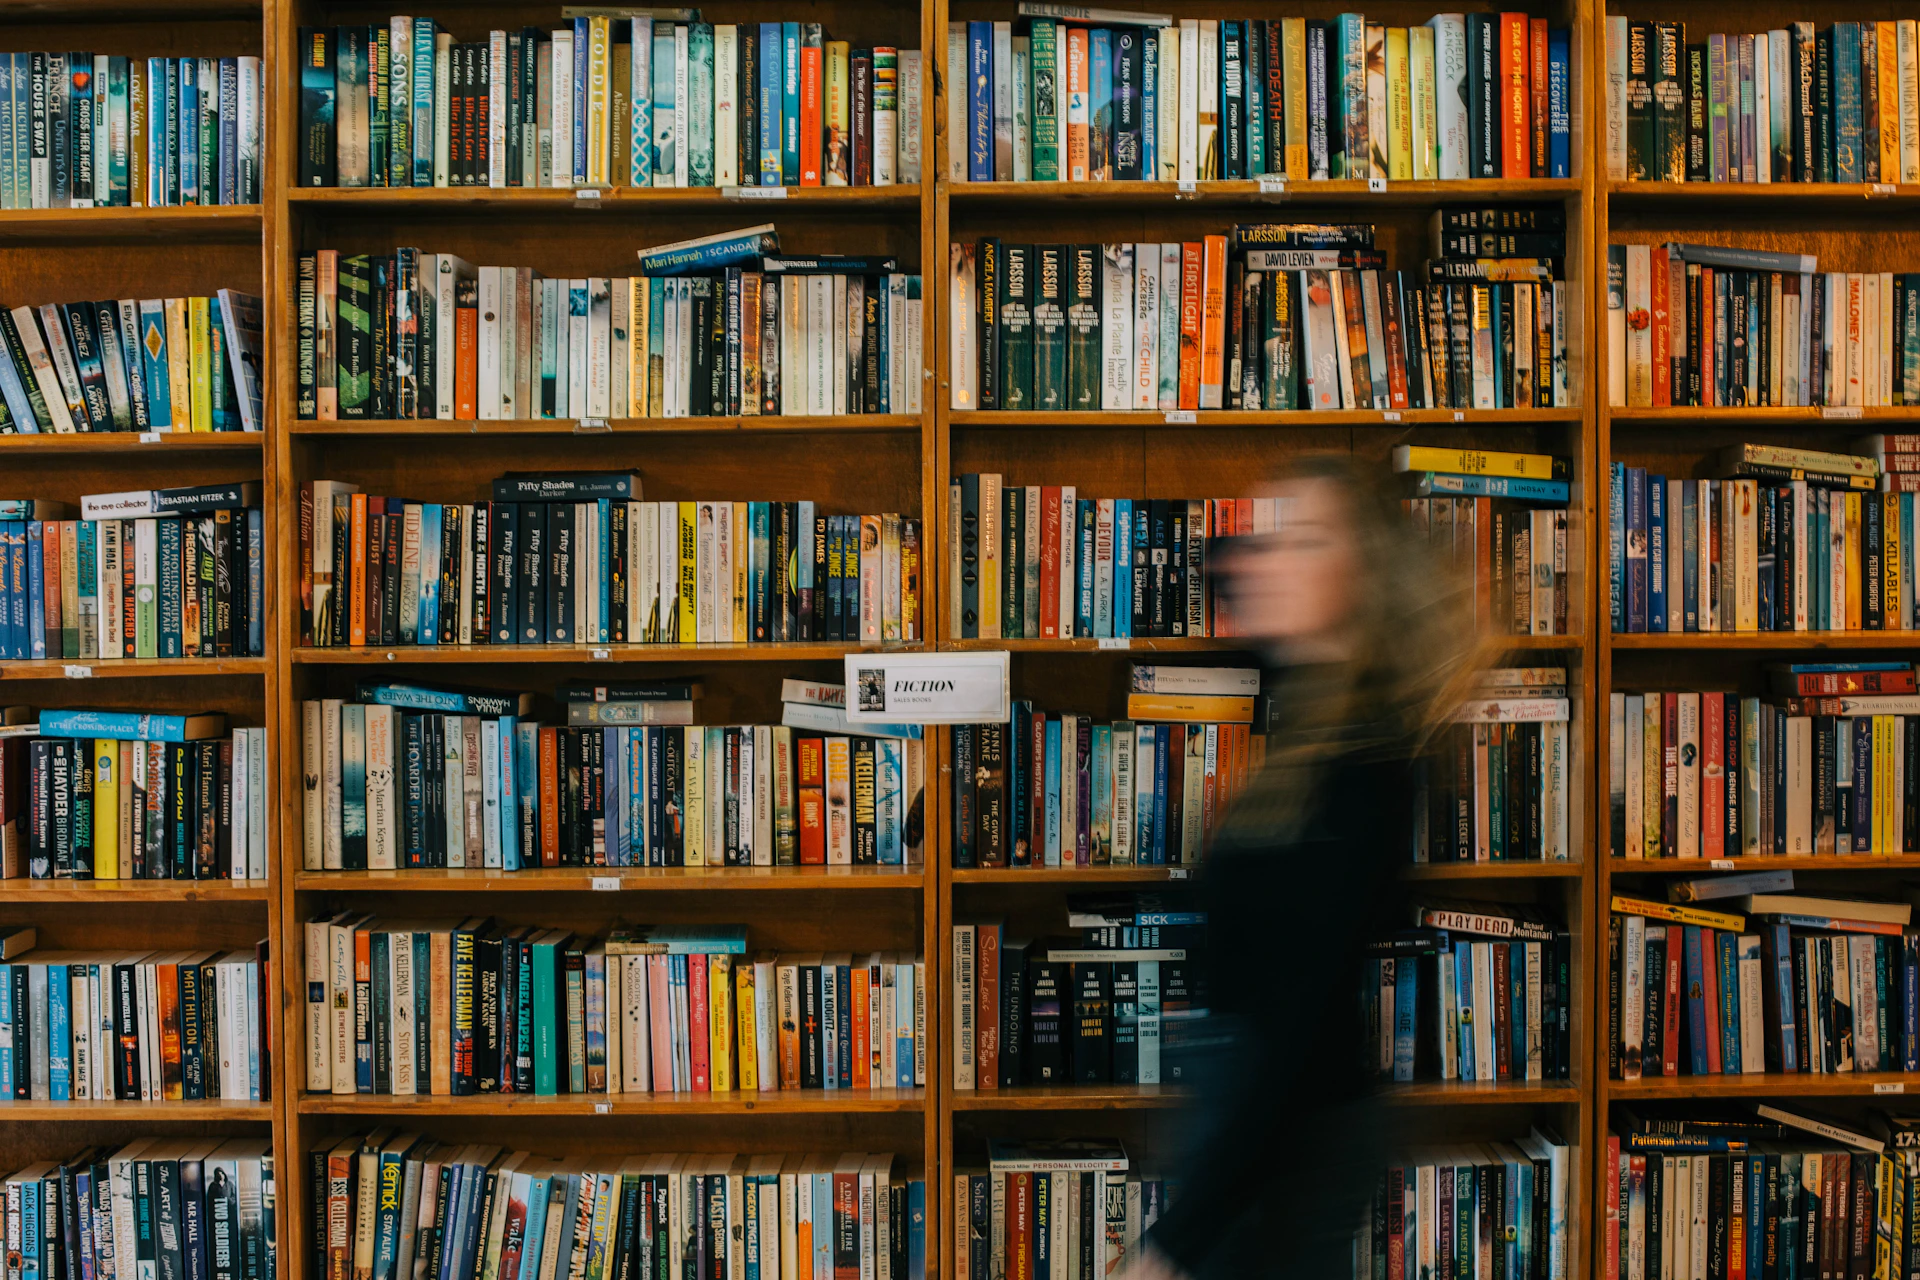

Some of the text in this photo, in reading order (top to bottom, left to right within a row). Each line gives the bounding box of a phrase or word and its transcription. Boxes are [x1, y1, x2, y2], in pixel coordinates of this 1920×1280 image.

[393, 32, 407, 106] & SONS
[593, 28, 605, 112] GOLDIE
[721, 36, 731, 97] Designer Genes
[768, 30, 778, 96] MIKE GAYLE
[1069, 36, 1080, 91] detainees
[1226, 40, 1240, 97] THE WIDOW
[1269, 33, 1281, 119] WHITE DEATH
[1445, 22, 1454, 80] HANCOCK
[1455, 32, 1464, 70] SHEILA
[1512, 22, 1522, 125] STAR OF THE NORTH
[1632, 27, 1645, 74] LARSSON
[33, 74, 44, 118] HOUSE
[613, 91, 622, 158] Abomination
[1551, 62, 1560, 134] DISCOVERER
[18, 101, 28, 197] MICHAEL FRAYN
[34, 121, 44, 155] SWAP
[79, 99, 91, 183] CROSS HER HEART
[1252, 92, 1262, 162] mistaken
[645, 250, 702, 270] Mari Hannah
[1242, 230, 1287, 243] LARSSON
[1265, 252, 1314, 266] DAVID LEVIEN
[299, 256, 315, 327] TONY HILLERMAN
[1009, 249, 1023, 297] LARSSON
[1077, 250, 1092, 297] LARSSON
[1184, 264, 1197, 332] FIRST LIGHT
[123, 305, 137, 363] Elly Griffiths
[634, 282, 643, 351] WASHINGTON BLACK
[765, 283, 775, 363] BENEATH THE ASHES
[1849, 283, 1860, 343] MALONEY
[1908, 290, 1917, 337] SANCTUM
[300, 338, 314, 385] TALKING GOD
[1140, 349, 1150, 387] CHILD
[87, 385, 102, 422] LAWYER
[88, 502, 100, 510] the
[116, 500, 148, 508] collector
[160, 493, 224, 504] SEBASTIAN FITZEK
[518, 480, 574, 490] Fifty Shades
[105, 525, 116, 570] TAMI HOAG
[405, 510, 420, 569] TIDELINE
[504, 531, 512, 554] Fifty
[1097, 522, 1111, 561] DEVOUR
[1118, 512, 1130, 567] sightseeing
[162, 523, 171, 633] THE SPARSHOLT AFFAIR
[186, 533, 196, 609] REGINALD HILL
[1081, 543, 1092, 618] UNWANTED GUEST
[1134, 568, 1142, 614] LEMAITRE
[1868, 555, 1878, 612] PETER MORFOOT
[1886, 541, 1897, 612] KILLABLES
[124, 597, 134, 638] HAPPENED
[894, 680, 956, 692] FICTION
[202, 745, 212, 808] Mari Hannah
[409, 742, 420, 800] HOARDER
[778, 741, 788, 806] JONATHAN KELLERMAN
[829, 743, 848, 783] GONE
[855, 757, 874, 823] KELLERMAN
[54, 767, 68, 862] HAYDER BIRDMAN
[374, 788, 386, 855] Marian Keyes
[804, 802, 819, 828] BONES
[865, 830, 873, 856] Silent
[1459, 819, 1468, 846] LECKIE
[857, 828, 865, 861] Partner
[1140, 915, 1168, 925] SICK
[1438, 912, 1509, 934] PLAY DEAD
[184, 970, 197, 1044] MATT HILTON
[456, 934, 473, 1030] FAYE KELLERMAN
[824, 973, 834, 1030] DEAN KOONTZ
[330, 1177, 348, 1247] JESSE KELLERMAN
[381, 1162, 399, 1210] Kernick
[658, 1189, 667, 1224] Payback
[974, 1182, 984, 1215] Solace
[25, 1185, 36, 1253] JACK HIGGINS
[188, 1220, 197, 1243] HALL
[214, 1197, 229, 1267] TWO SOLDIERS
[381, 1214, 393, 1260] STAY ALIVE
[747, 1183, 757, 1263] PIGEON ENGLISH
[1390, 1204, 1403, 1234] MUSSI
